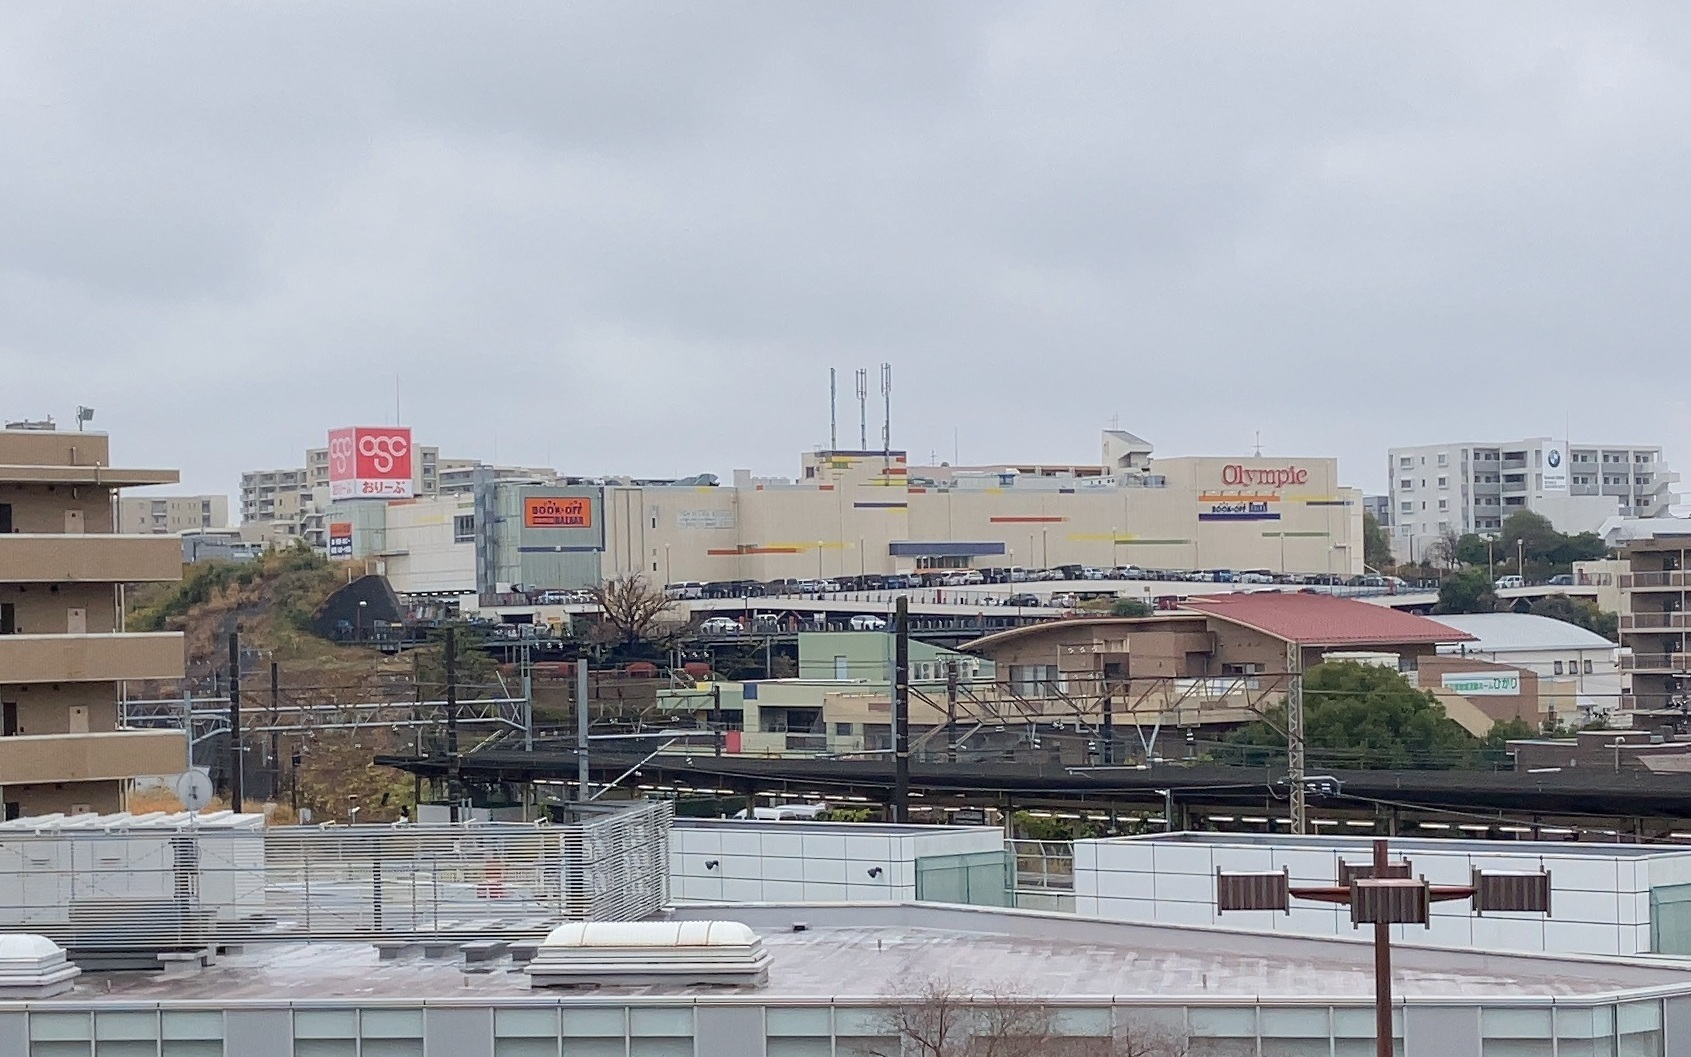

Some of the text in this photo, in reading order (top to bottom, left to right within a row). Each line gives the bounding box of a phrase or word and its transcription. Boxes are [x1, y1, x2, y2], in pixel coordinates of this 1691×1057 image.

[359, 435, 407, 473] OSC
[362, 481, 406, 494] おりーぶ
[1222, 464, 1308, 488] Olympic
